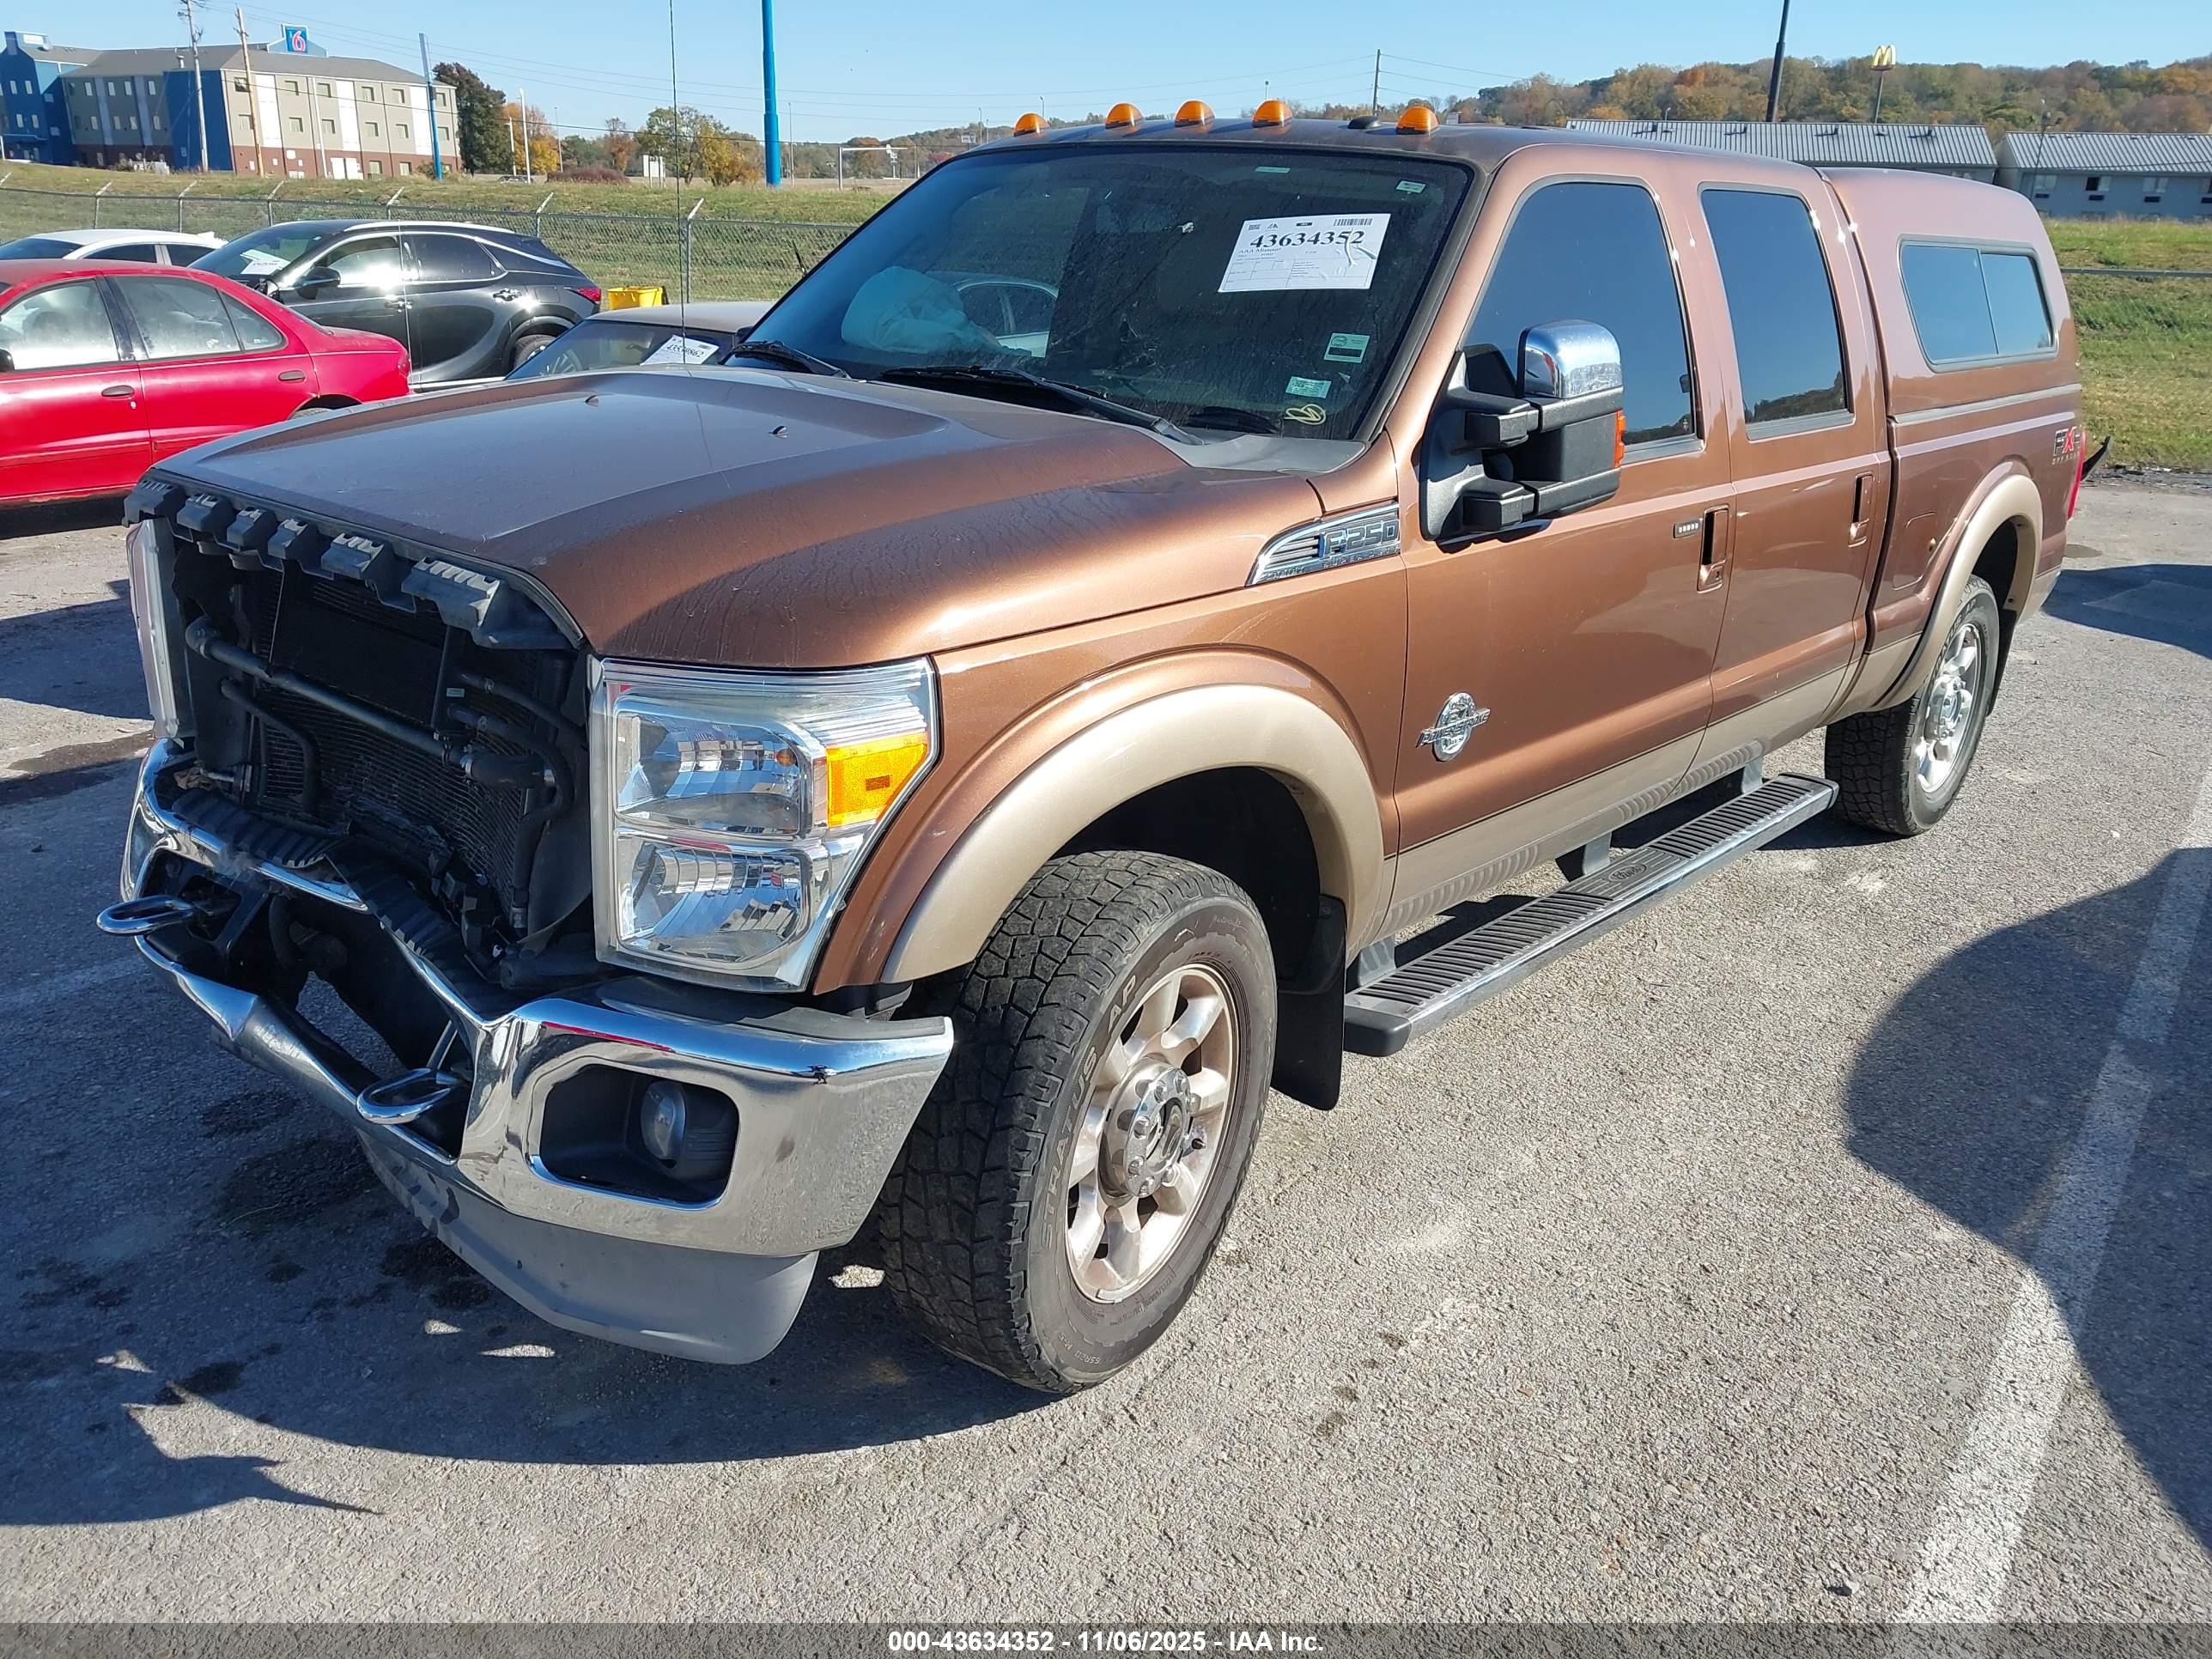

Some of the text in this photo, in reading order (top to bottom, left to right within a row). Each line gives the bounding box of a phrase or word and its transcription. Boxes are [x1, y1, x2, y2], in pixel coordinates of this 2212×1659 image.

[292, 30, 306, 52] 6
[1249, 230, 1365, 248] 43634352
[1041, 974, 1137, 1250] STRATUS AP
